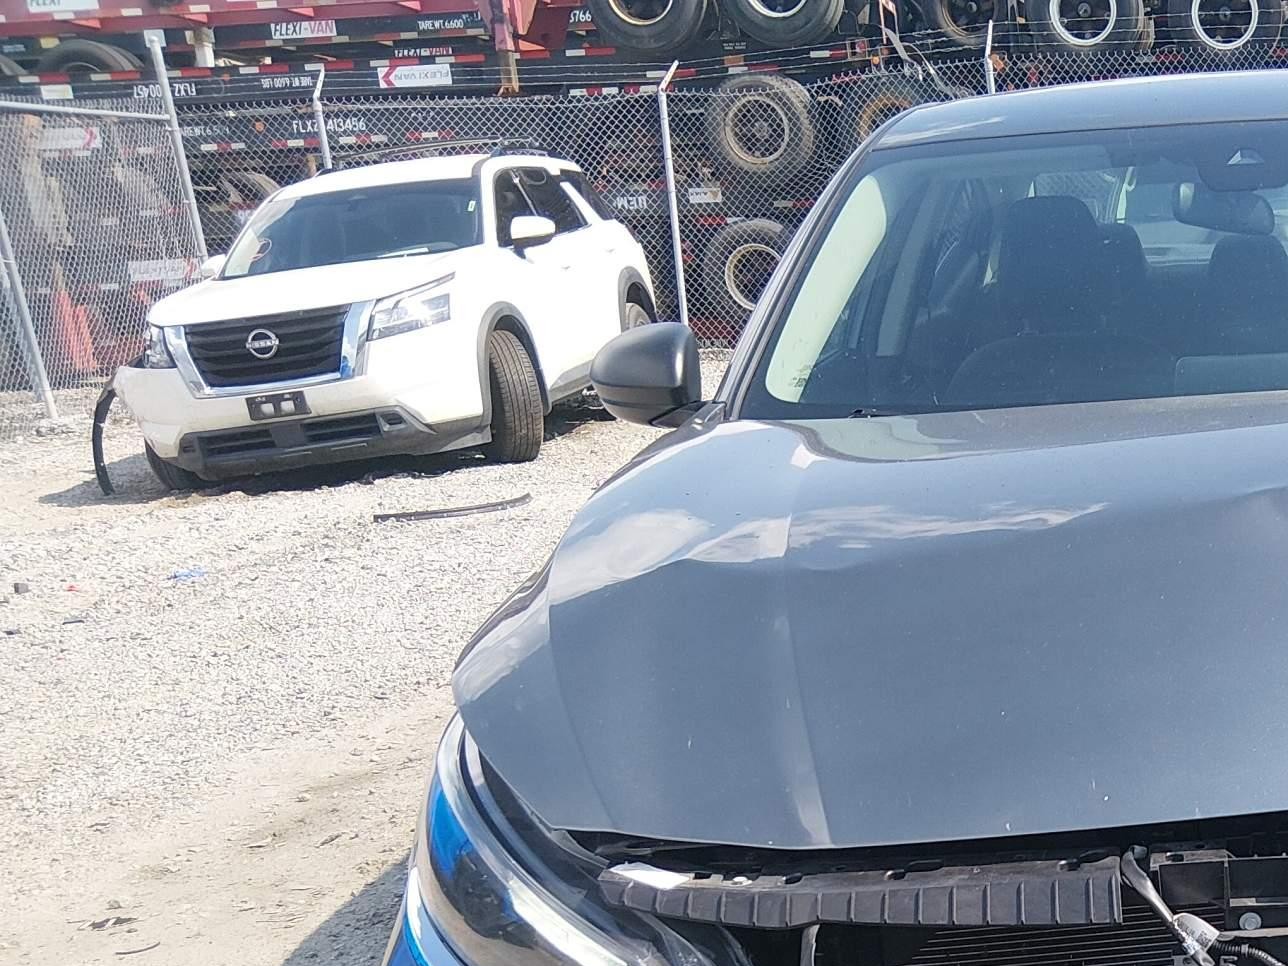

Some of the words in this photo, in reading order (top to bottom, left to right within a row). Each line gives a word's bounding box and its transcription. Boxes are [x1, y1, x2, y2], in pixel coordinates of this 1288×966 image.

[273, 21, 334, 37] FLEXI-VAN
[172, 83, 197, 97] FLXZ
[292, 119, 319, 133] FLXZ
